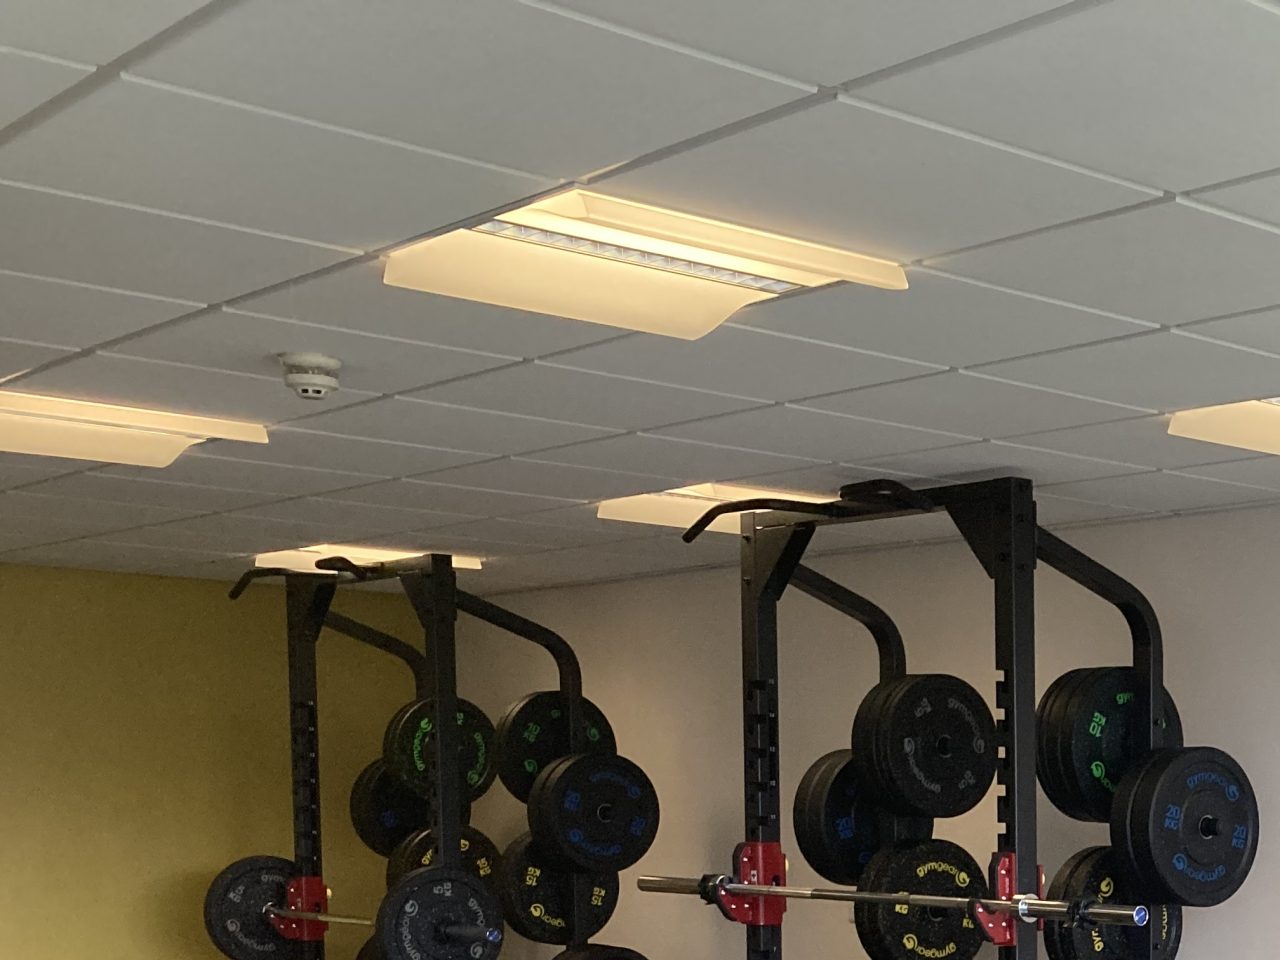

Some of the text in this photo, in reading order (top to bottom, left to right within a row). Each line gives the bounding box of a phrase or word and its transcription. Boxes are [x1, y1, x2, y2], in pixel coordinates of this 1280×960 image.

[1186, 772, 1227, 789] gymgear
[1165, 804, 1182, 819] 20
[1233, 825, 1248, 838] 20
[527, 866, 541, 877] KG
[917, 862, 957, 878] gymgear
[1185, 864, 1226, 881] gymgear
[525, 875, 537, 887] 15
[443, 882, 452, 896] KG
[593, 887, 606, 897] KG
[591, 896, 603, 906] 15
[894, 904, 909, 915] KG
[401, 915, 421, 960] gymgear
[915, 942, 956, 958] gymgear
